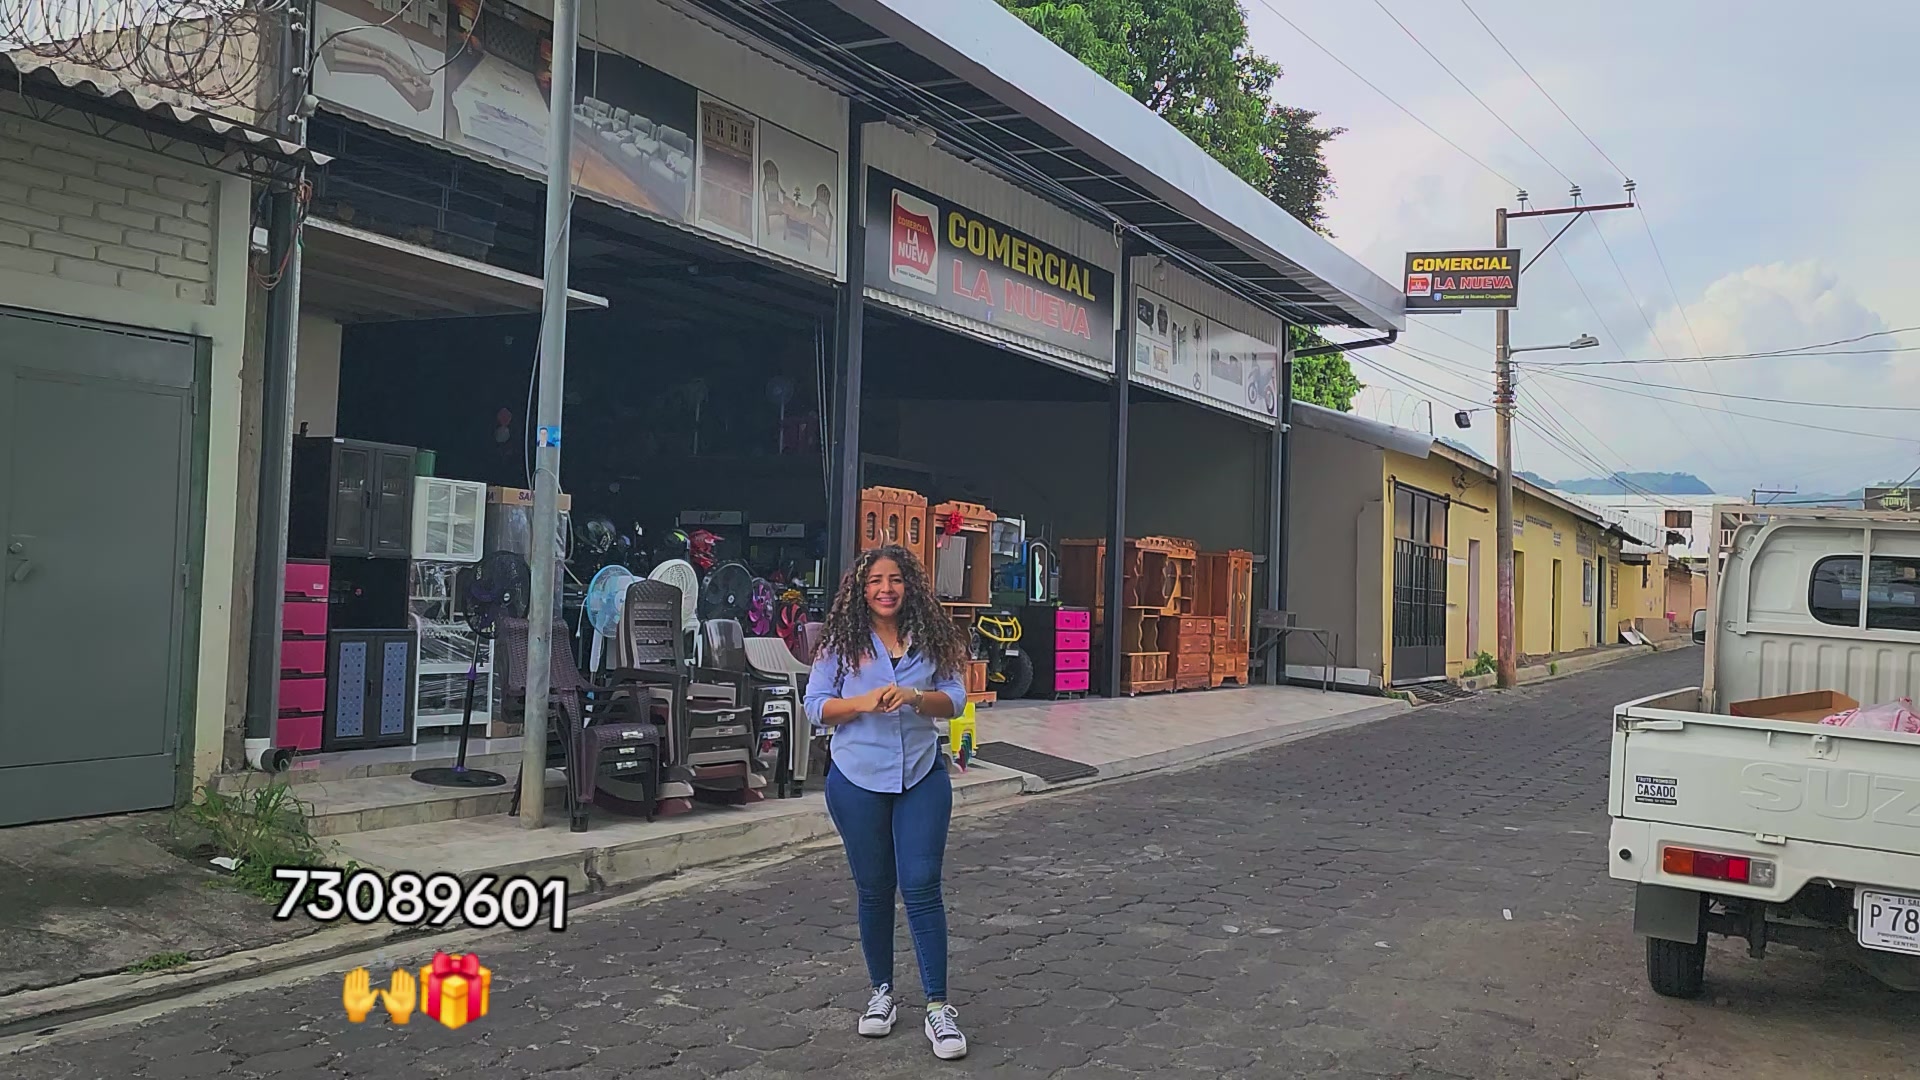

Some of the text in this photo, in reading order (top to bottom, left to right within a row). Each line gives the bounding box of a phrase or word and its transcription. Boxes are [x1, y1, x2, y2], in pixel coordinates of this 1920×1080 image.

[897, 215, 929, 235] COMERCIAL
[907, 228, 919, 246] LA
[898, 241, 929, 266] NUEVA
[948, 211, 1095, 302] COMERCIAL
[1412, 256, 1512, 271] COMERCIAL
[1433, 275, 1514, 290] LA NUEVA
[953, 259, 995, 306] LA
[1004, 278, 1091, 340] NUEVA
[1637, 783, 1676, 798] CASADO
[1897, 897, 1905, 905] EL
[1870, 903, 1920, 934] P 78
